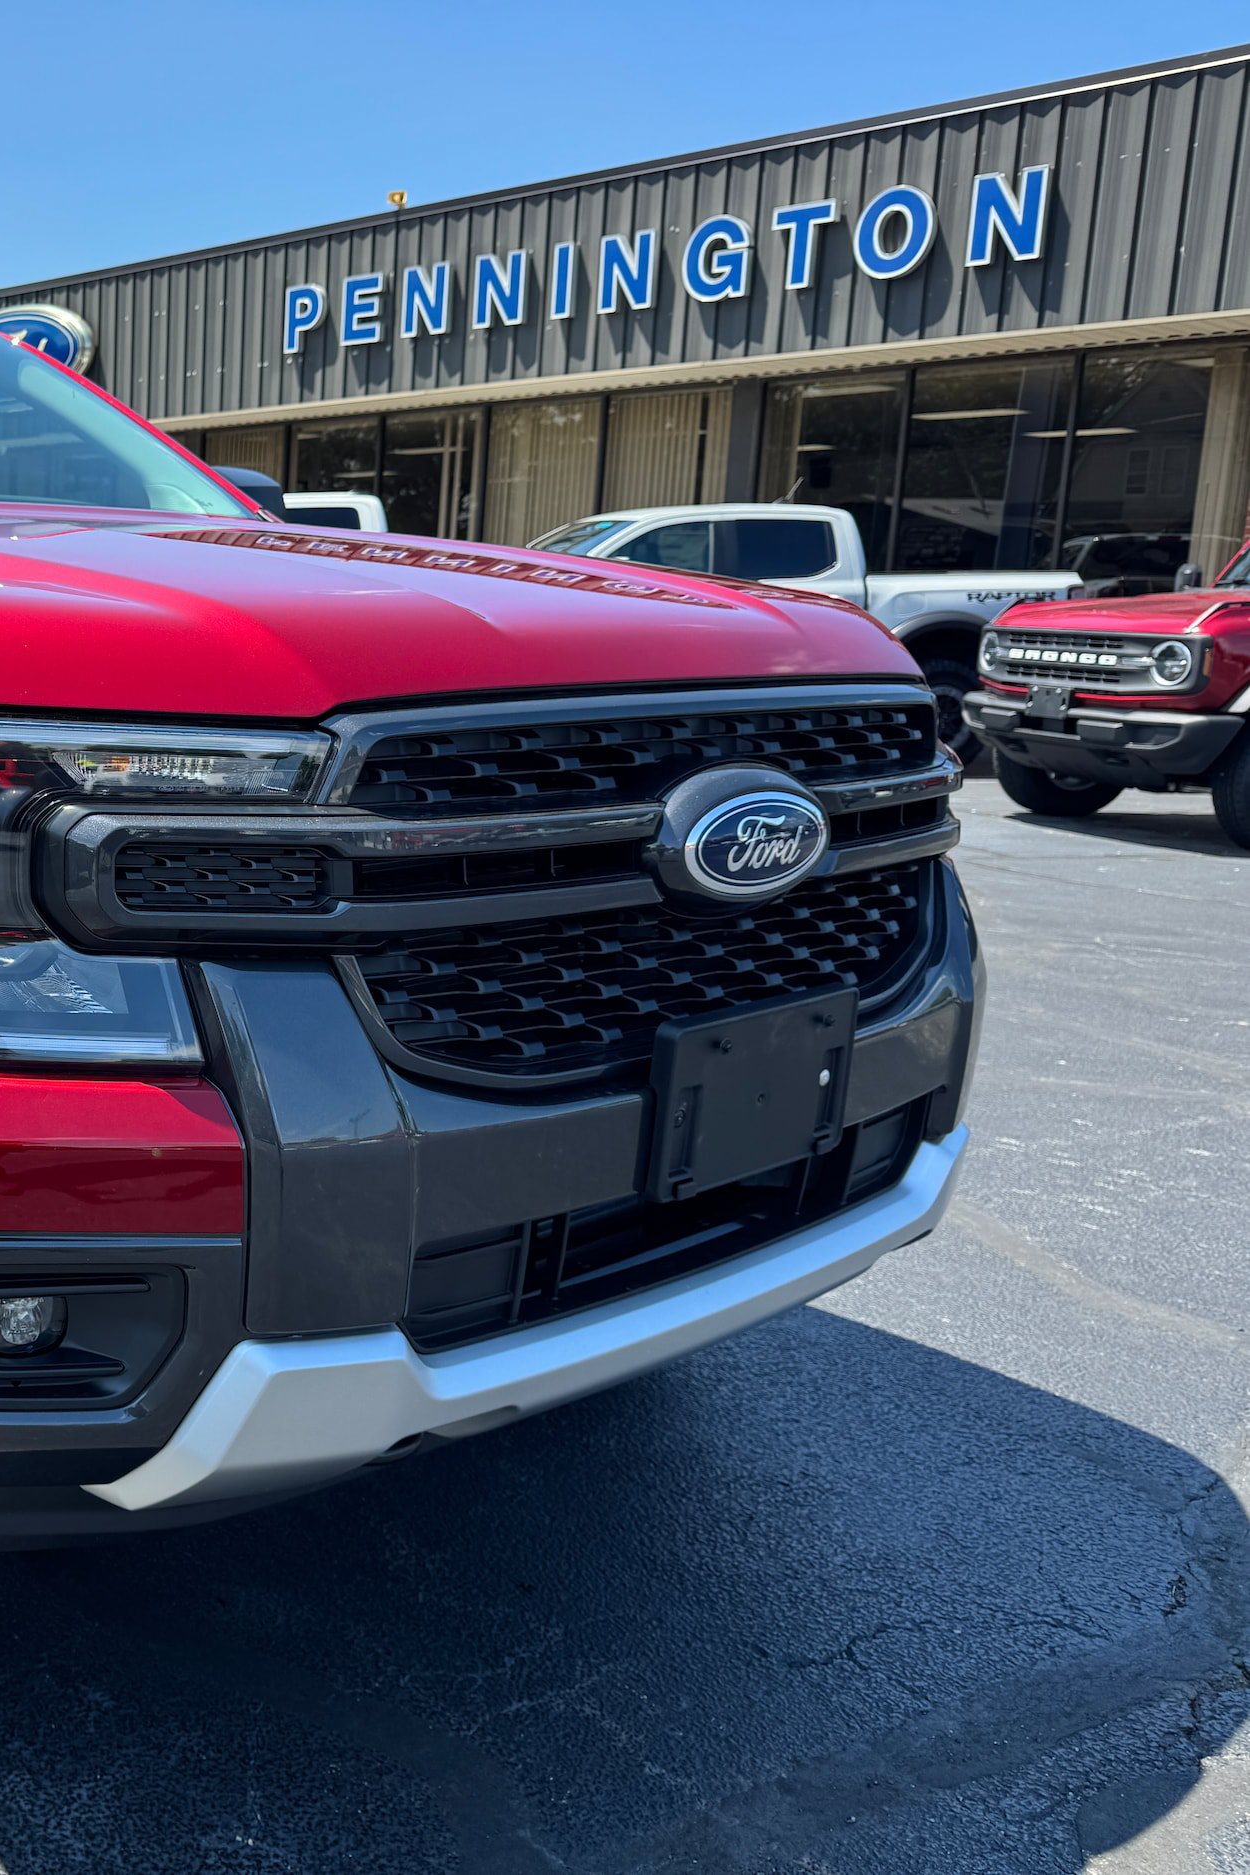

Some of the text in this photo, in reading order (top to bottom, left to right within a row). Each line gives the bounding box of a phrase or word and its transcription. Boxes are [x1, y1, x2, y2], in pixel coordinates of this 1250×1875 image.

[282, 164, 1050, 354] PENNINGTON
[1008, 648, 1118, 666] BRONCO
[727, 815, 803, 872] Ford
